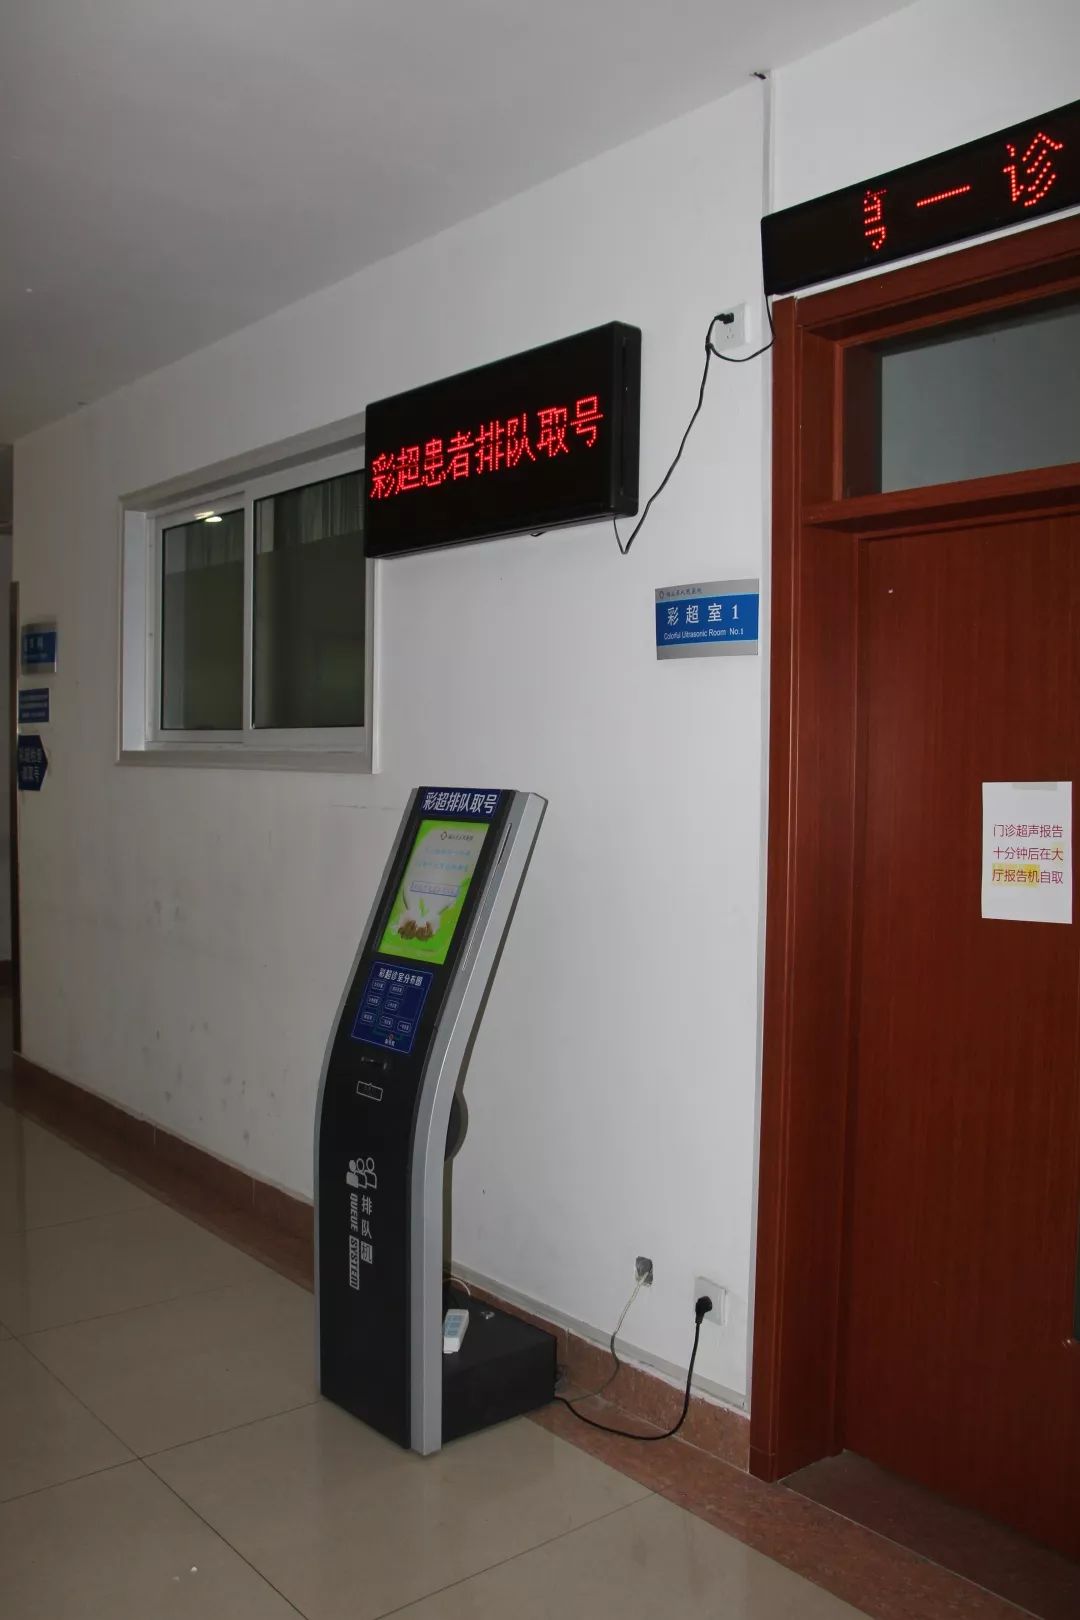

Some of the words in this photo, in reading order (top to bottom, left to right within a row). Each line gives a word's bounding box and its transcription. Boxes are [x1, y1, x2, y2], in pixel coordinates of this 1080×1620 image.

[369, 394, 604, 500] 彩超患者排队取号
[682, 629, 708, 639] Ultrasonic
[708, 628, 727, 637] Room
[729, 627, 744, 636] No.1
[422, 791, 498, 815] 彩超排队取号
[993, 824, 1064, 838] 门诊超声报告
[993, 846, 1064, 861] 十分钟后在大
[992, 869, 1064, 885] 厅报告机自取
[349, 1192, 360, 1233] QUEUE
[349, 1235, 360, 1291] SYSTEM
